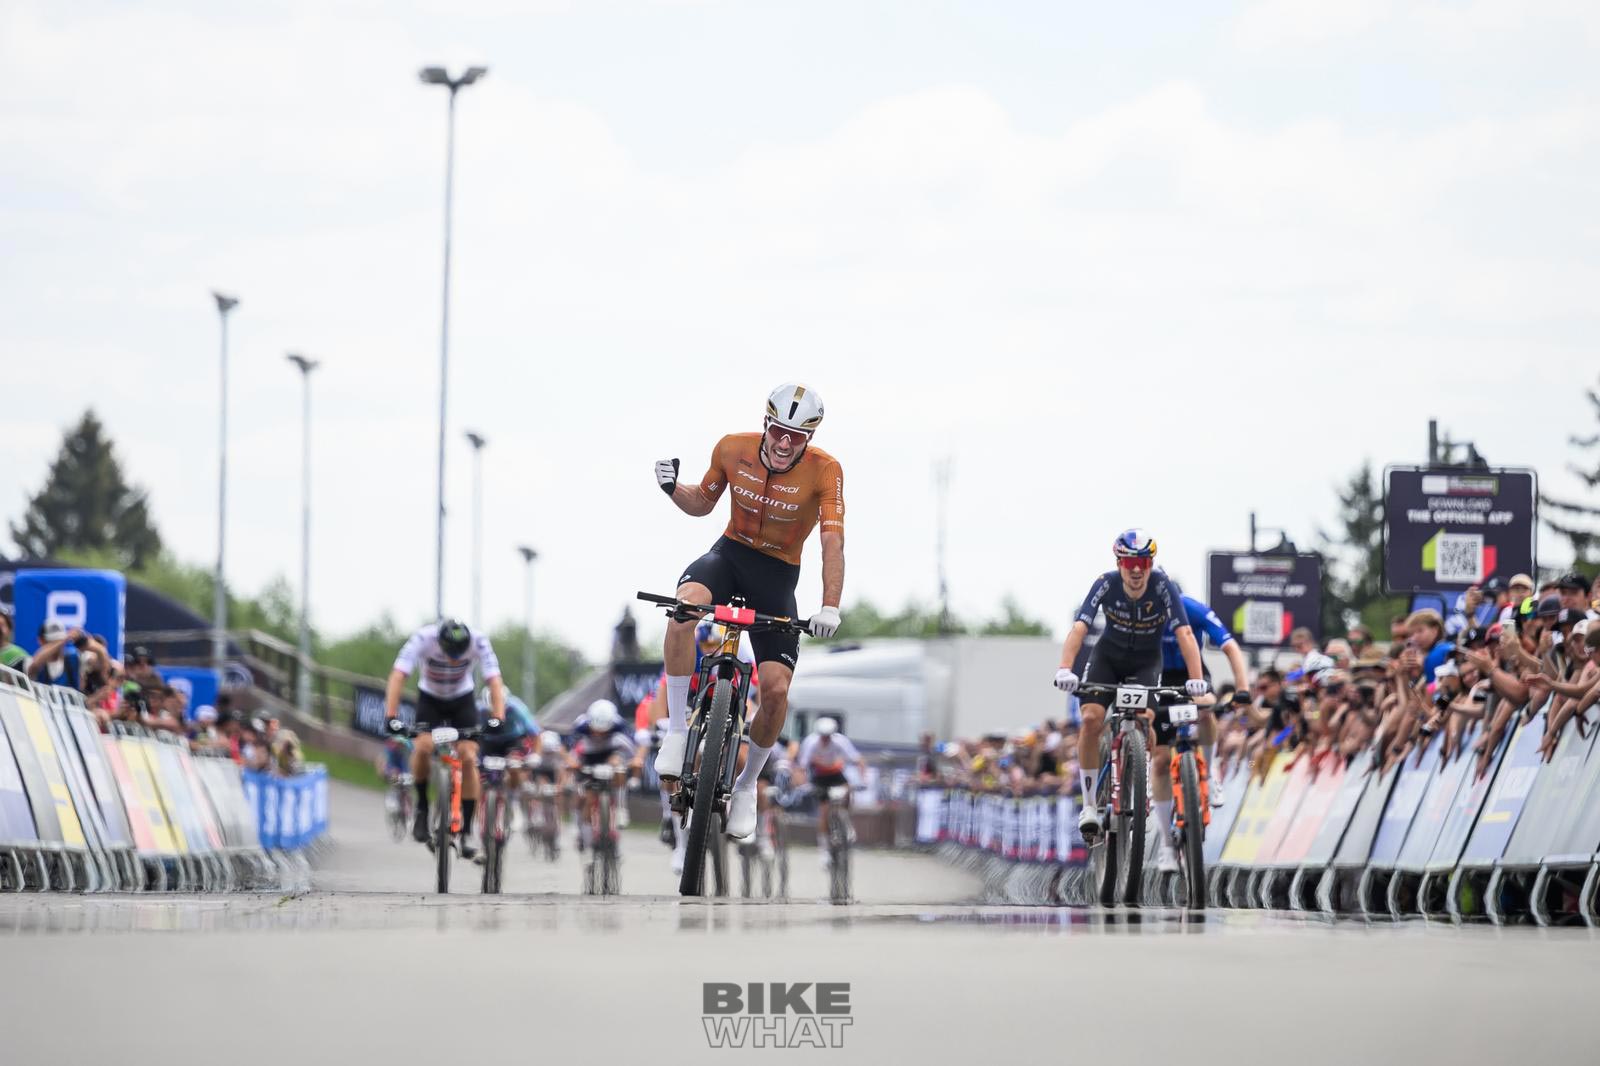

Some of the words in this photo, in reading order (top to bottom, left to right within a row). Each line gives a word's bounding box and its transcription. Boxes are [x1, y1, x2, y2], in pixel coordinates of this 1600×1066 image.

[1406, 509, 1431, 523] THE
[1433, 510, 1485, 524] OFFICIAL
[1488, 511, 1514, 525] APP
[1122, 693, 1143, 705] 37
